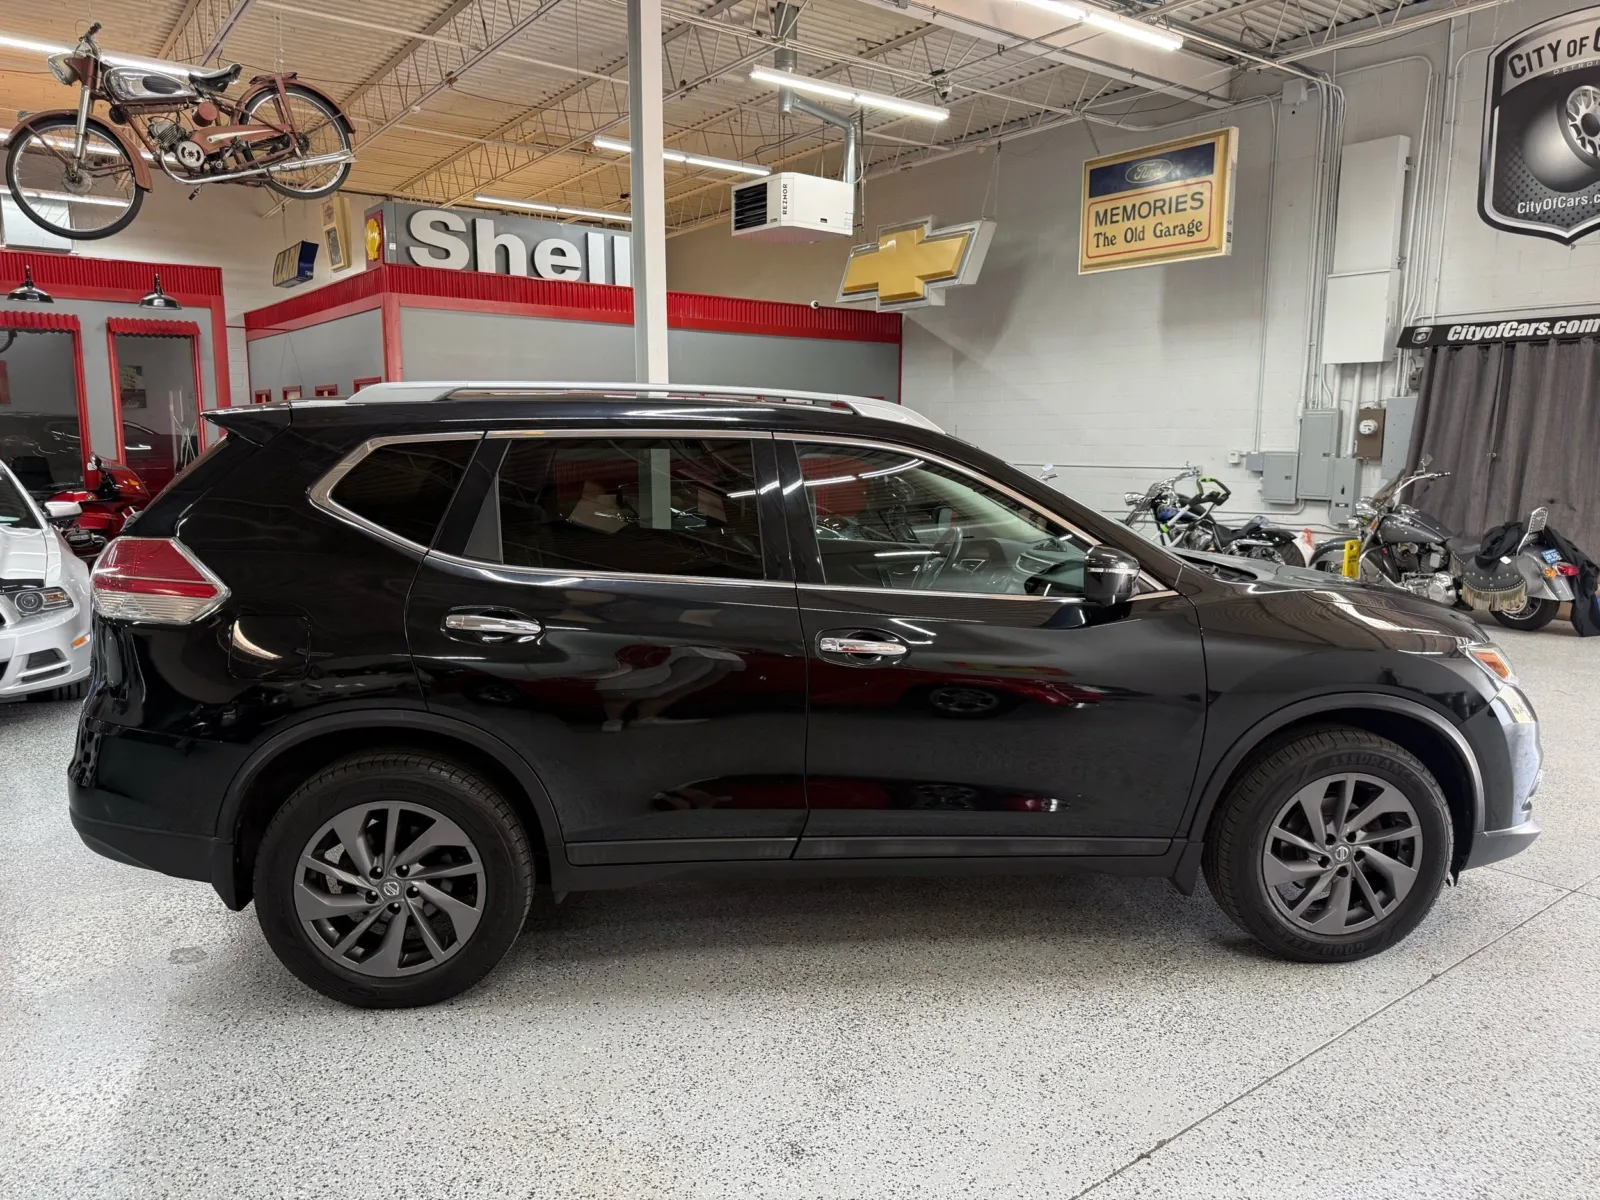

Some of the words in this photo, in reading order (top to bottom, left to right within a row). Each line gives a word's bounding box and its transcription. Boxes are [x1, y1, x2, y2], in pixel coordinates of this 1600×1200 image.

[1508, 38, 1562, 79] CITY
[1566, 36, 1590, 58] OF
[1133, 162, 1166, 180] Ford
[1094, 191, 1205, 228] MEMORIES
[408, 209, 631, 288] Shell
[1093, 232, 1117, 249] The
[1123, 225, 1146, 244] Old
[1152, 218, 1204, 239] Garage
[1447, 317, 1600, 342] CityofCars.com
